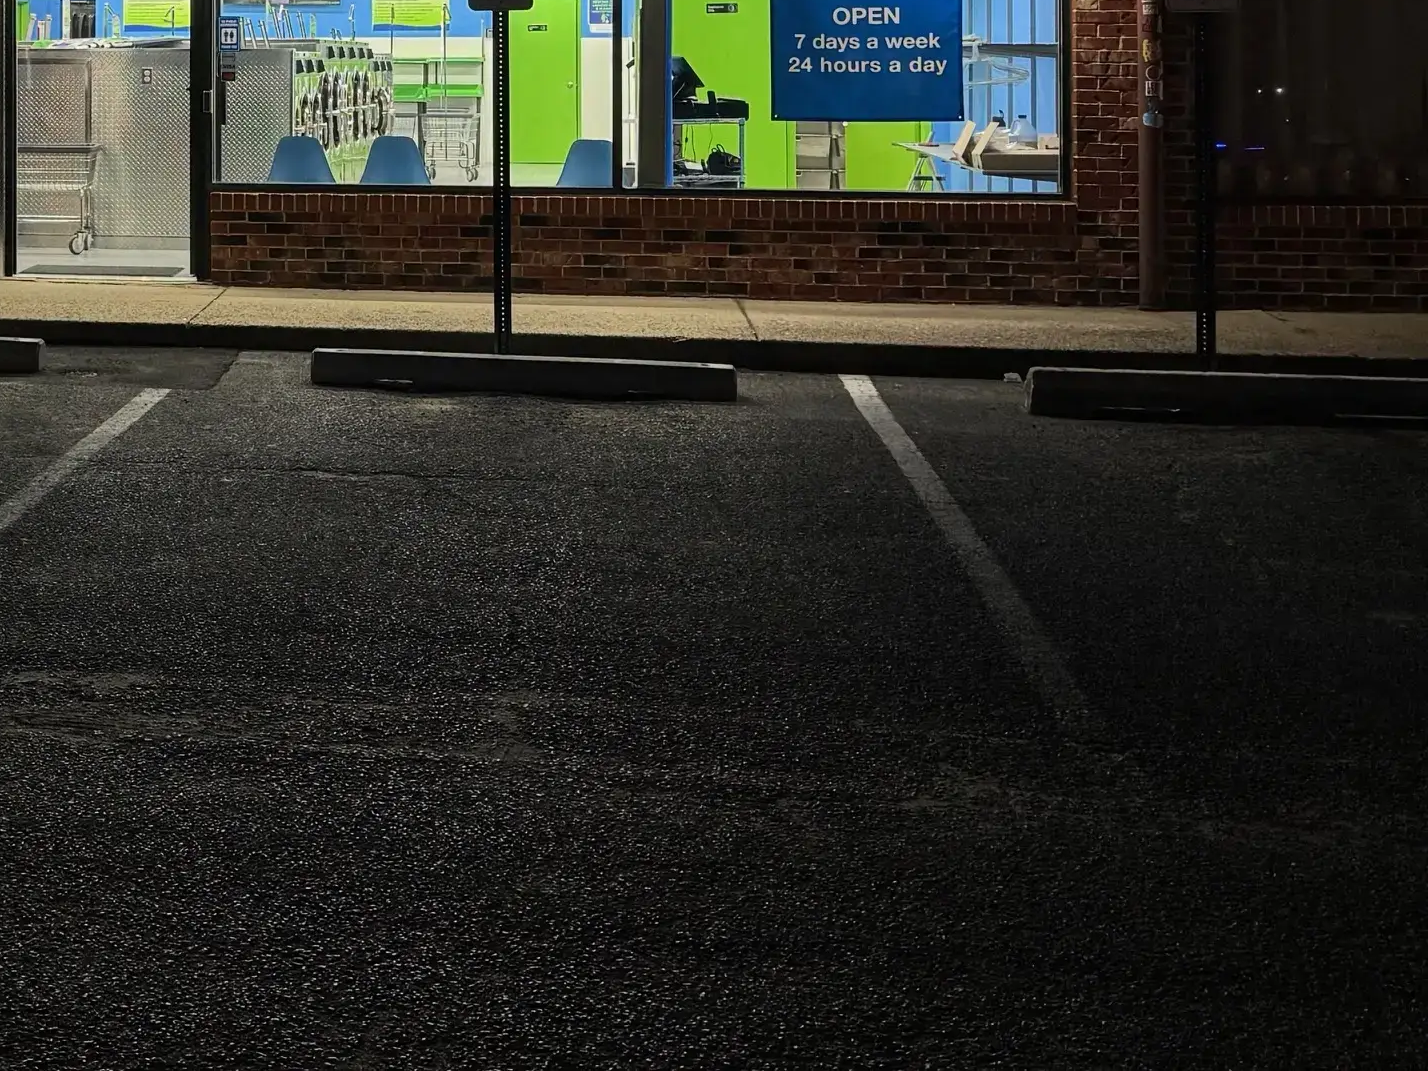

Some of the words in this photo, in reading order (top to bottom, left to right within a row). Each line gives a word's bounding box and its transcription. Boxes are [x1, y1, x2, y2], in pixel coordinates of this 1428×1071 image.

[832, 7, 901, 25] OPEN
[794, 34, 806, 49] 7
[812, 33, 860, 52] days
[866, 37, 879, 49] a
[885, 33, 941, 49] week
[788, 57, 813, 73] 24
[820, 57, 881, 73] hours
[889, 61, 902, 73] a
[909, 57, 947, 75] day
